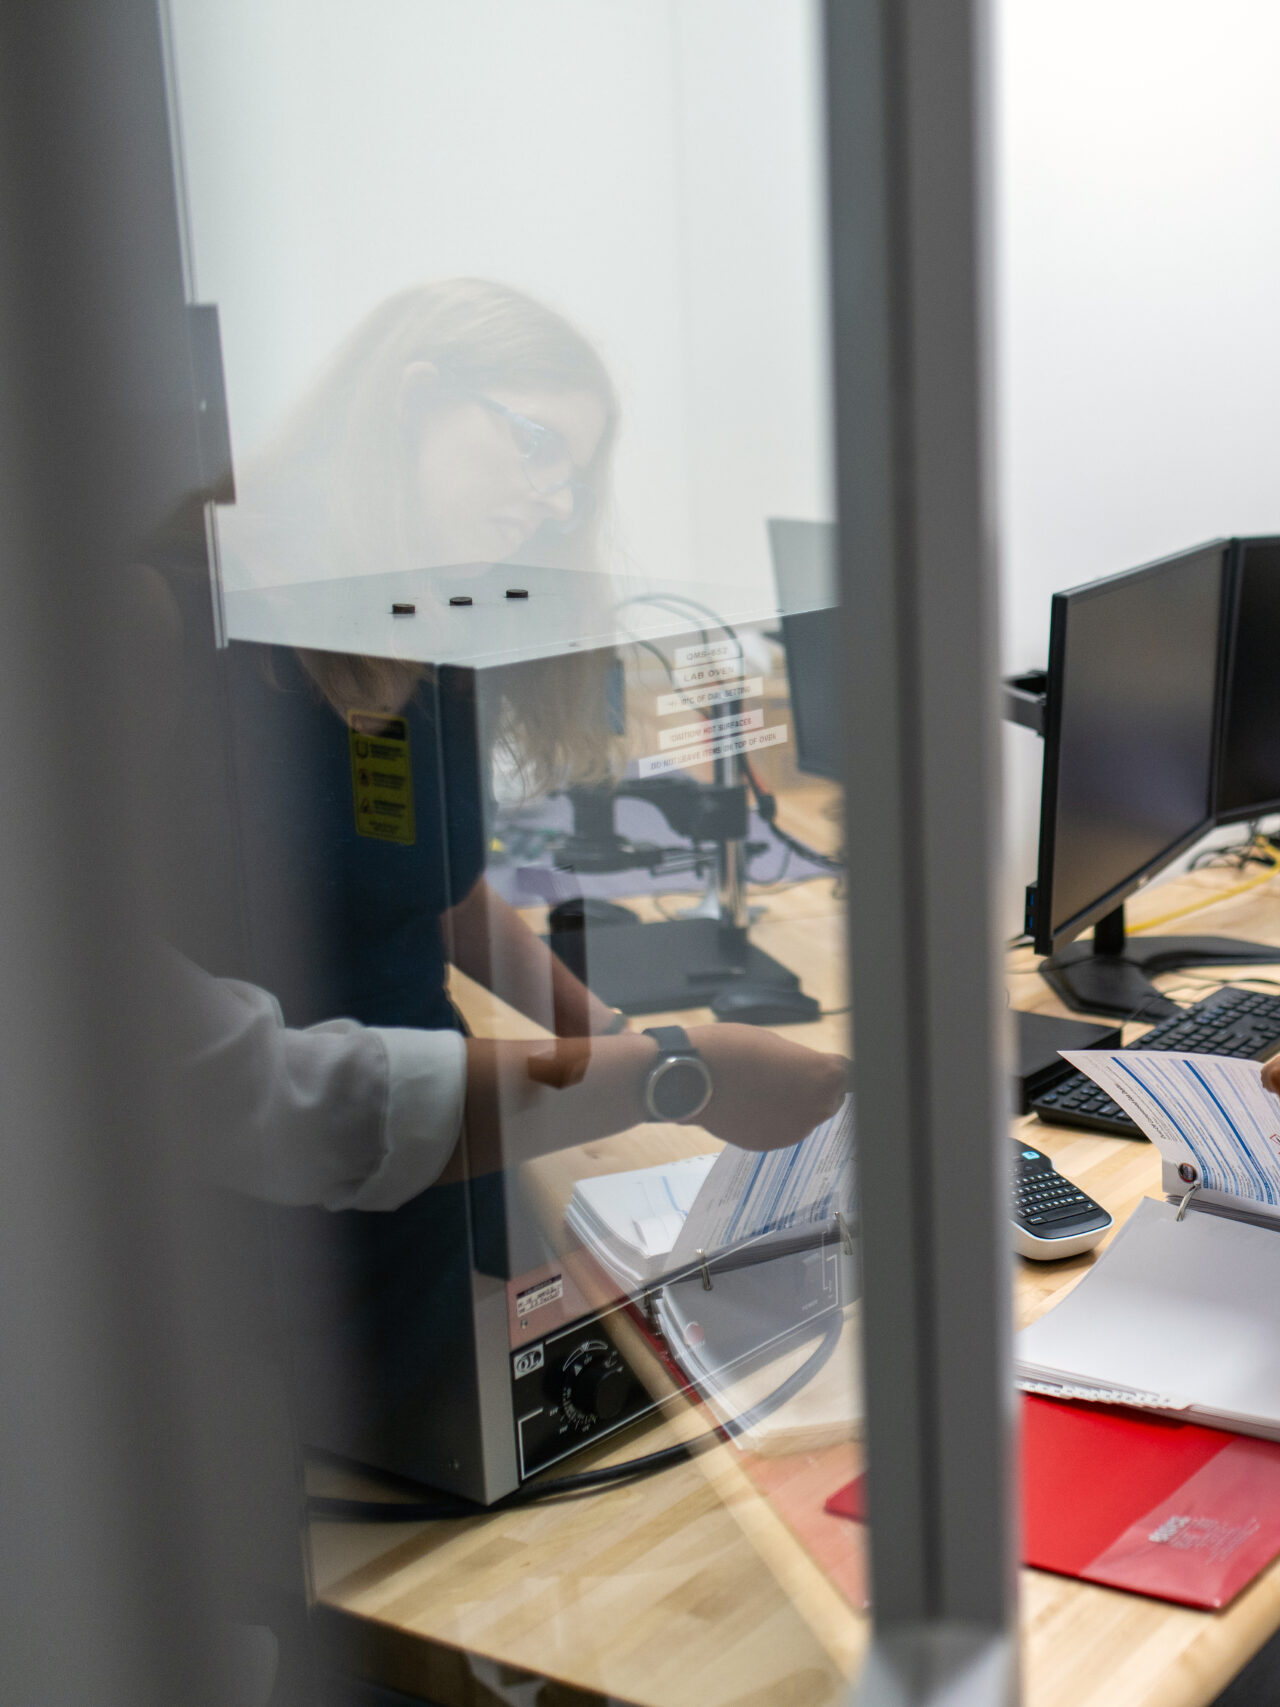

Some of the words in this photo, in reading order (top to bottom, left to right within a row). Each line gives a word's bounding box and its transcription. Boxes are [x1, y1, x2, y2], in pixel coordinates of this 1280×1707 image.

[683, 672, 704, 682] LAB
[708, 667, 735, 678] OVEN
[734, 740, 747, 751] TOP
[749, 738, 758, 747] OF
[759, 733, 777, 744] OVEN
